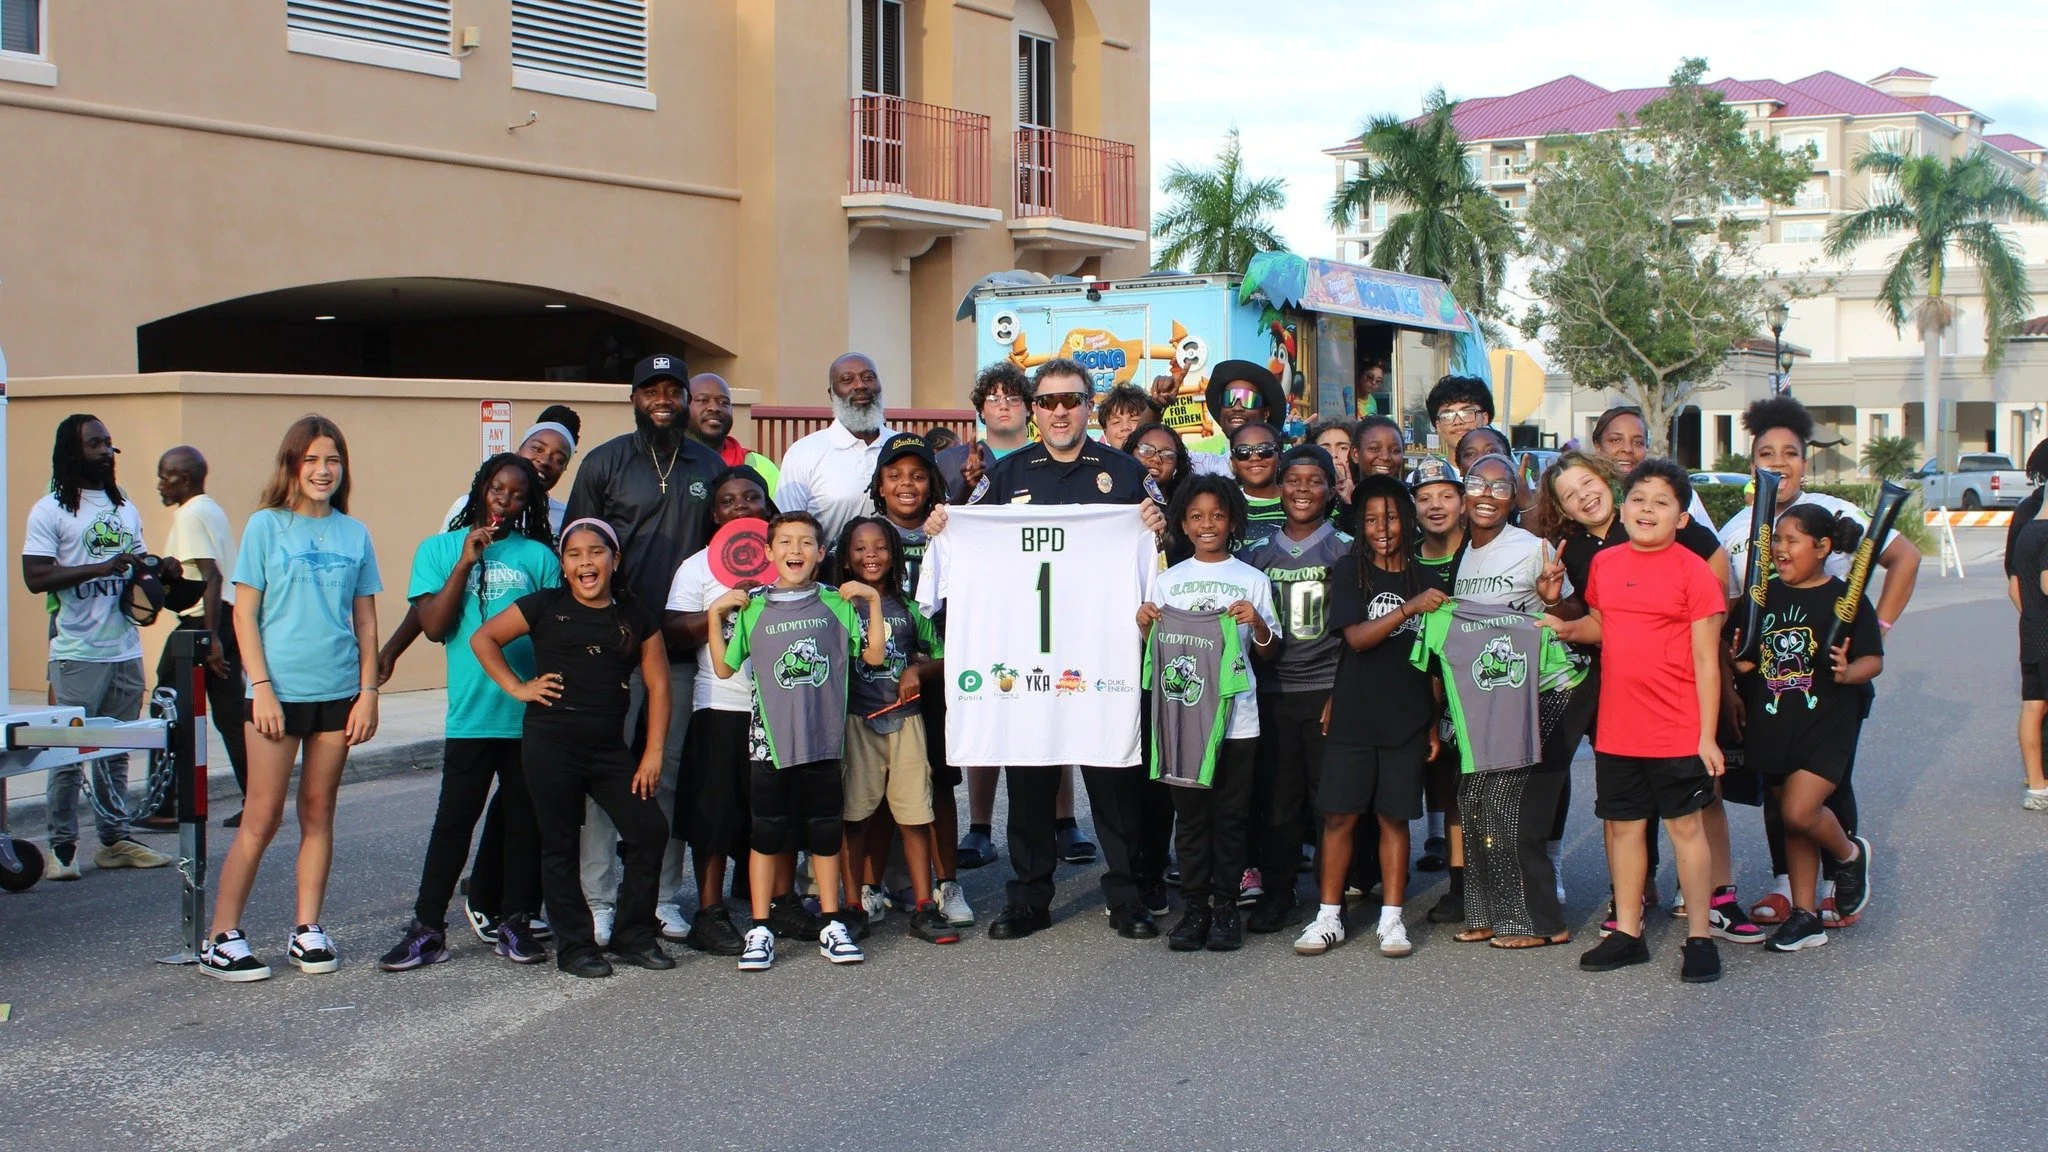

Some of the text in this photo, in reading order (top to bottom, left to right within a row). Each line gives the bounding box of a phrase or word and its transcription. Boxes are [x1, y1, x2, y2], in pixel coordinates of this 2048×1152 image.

[1072, 348, 1126, 370] KONA
[1092, 371, 1115, 393] CE
[1169, 395, 1193, 407] ATCH
[482, 407, 493, 418] NO
[1164, 413, 1202, 426] HILDREN
[1170, 406, 1187, 416] FOR
[489, 428, 504, 440] ANY
[488, 444, 505, 456] TIME
[1021, 527, 1065, 552] BPD
[1749, 523, 1771, 608] Bradenton
[471, 568, 528, 584] JHNSON
[1456, 575, 1514, 595] ADIATORS
[1170, 580, 1248, 600] GLADIATORS
[1035, 560, 1052, 654] 1
[765, 617, 828, 635] GLADIATORS
[1025, 675, 1050, 693] YKA
